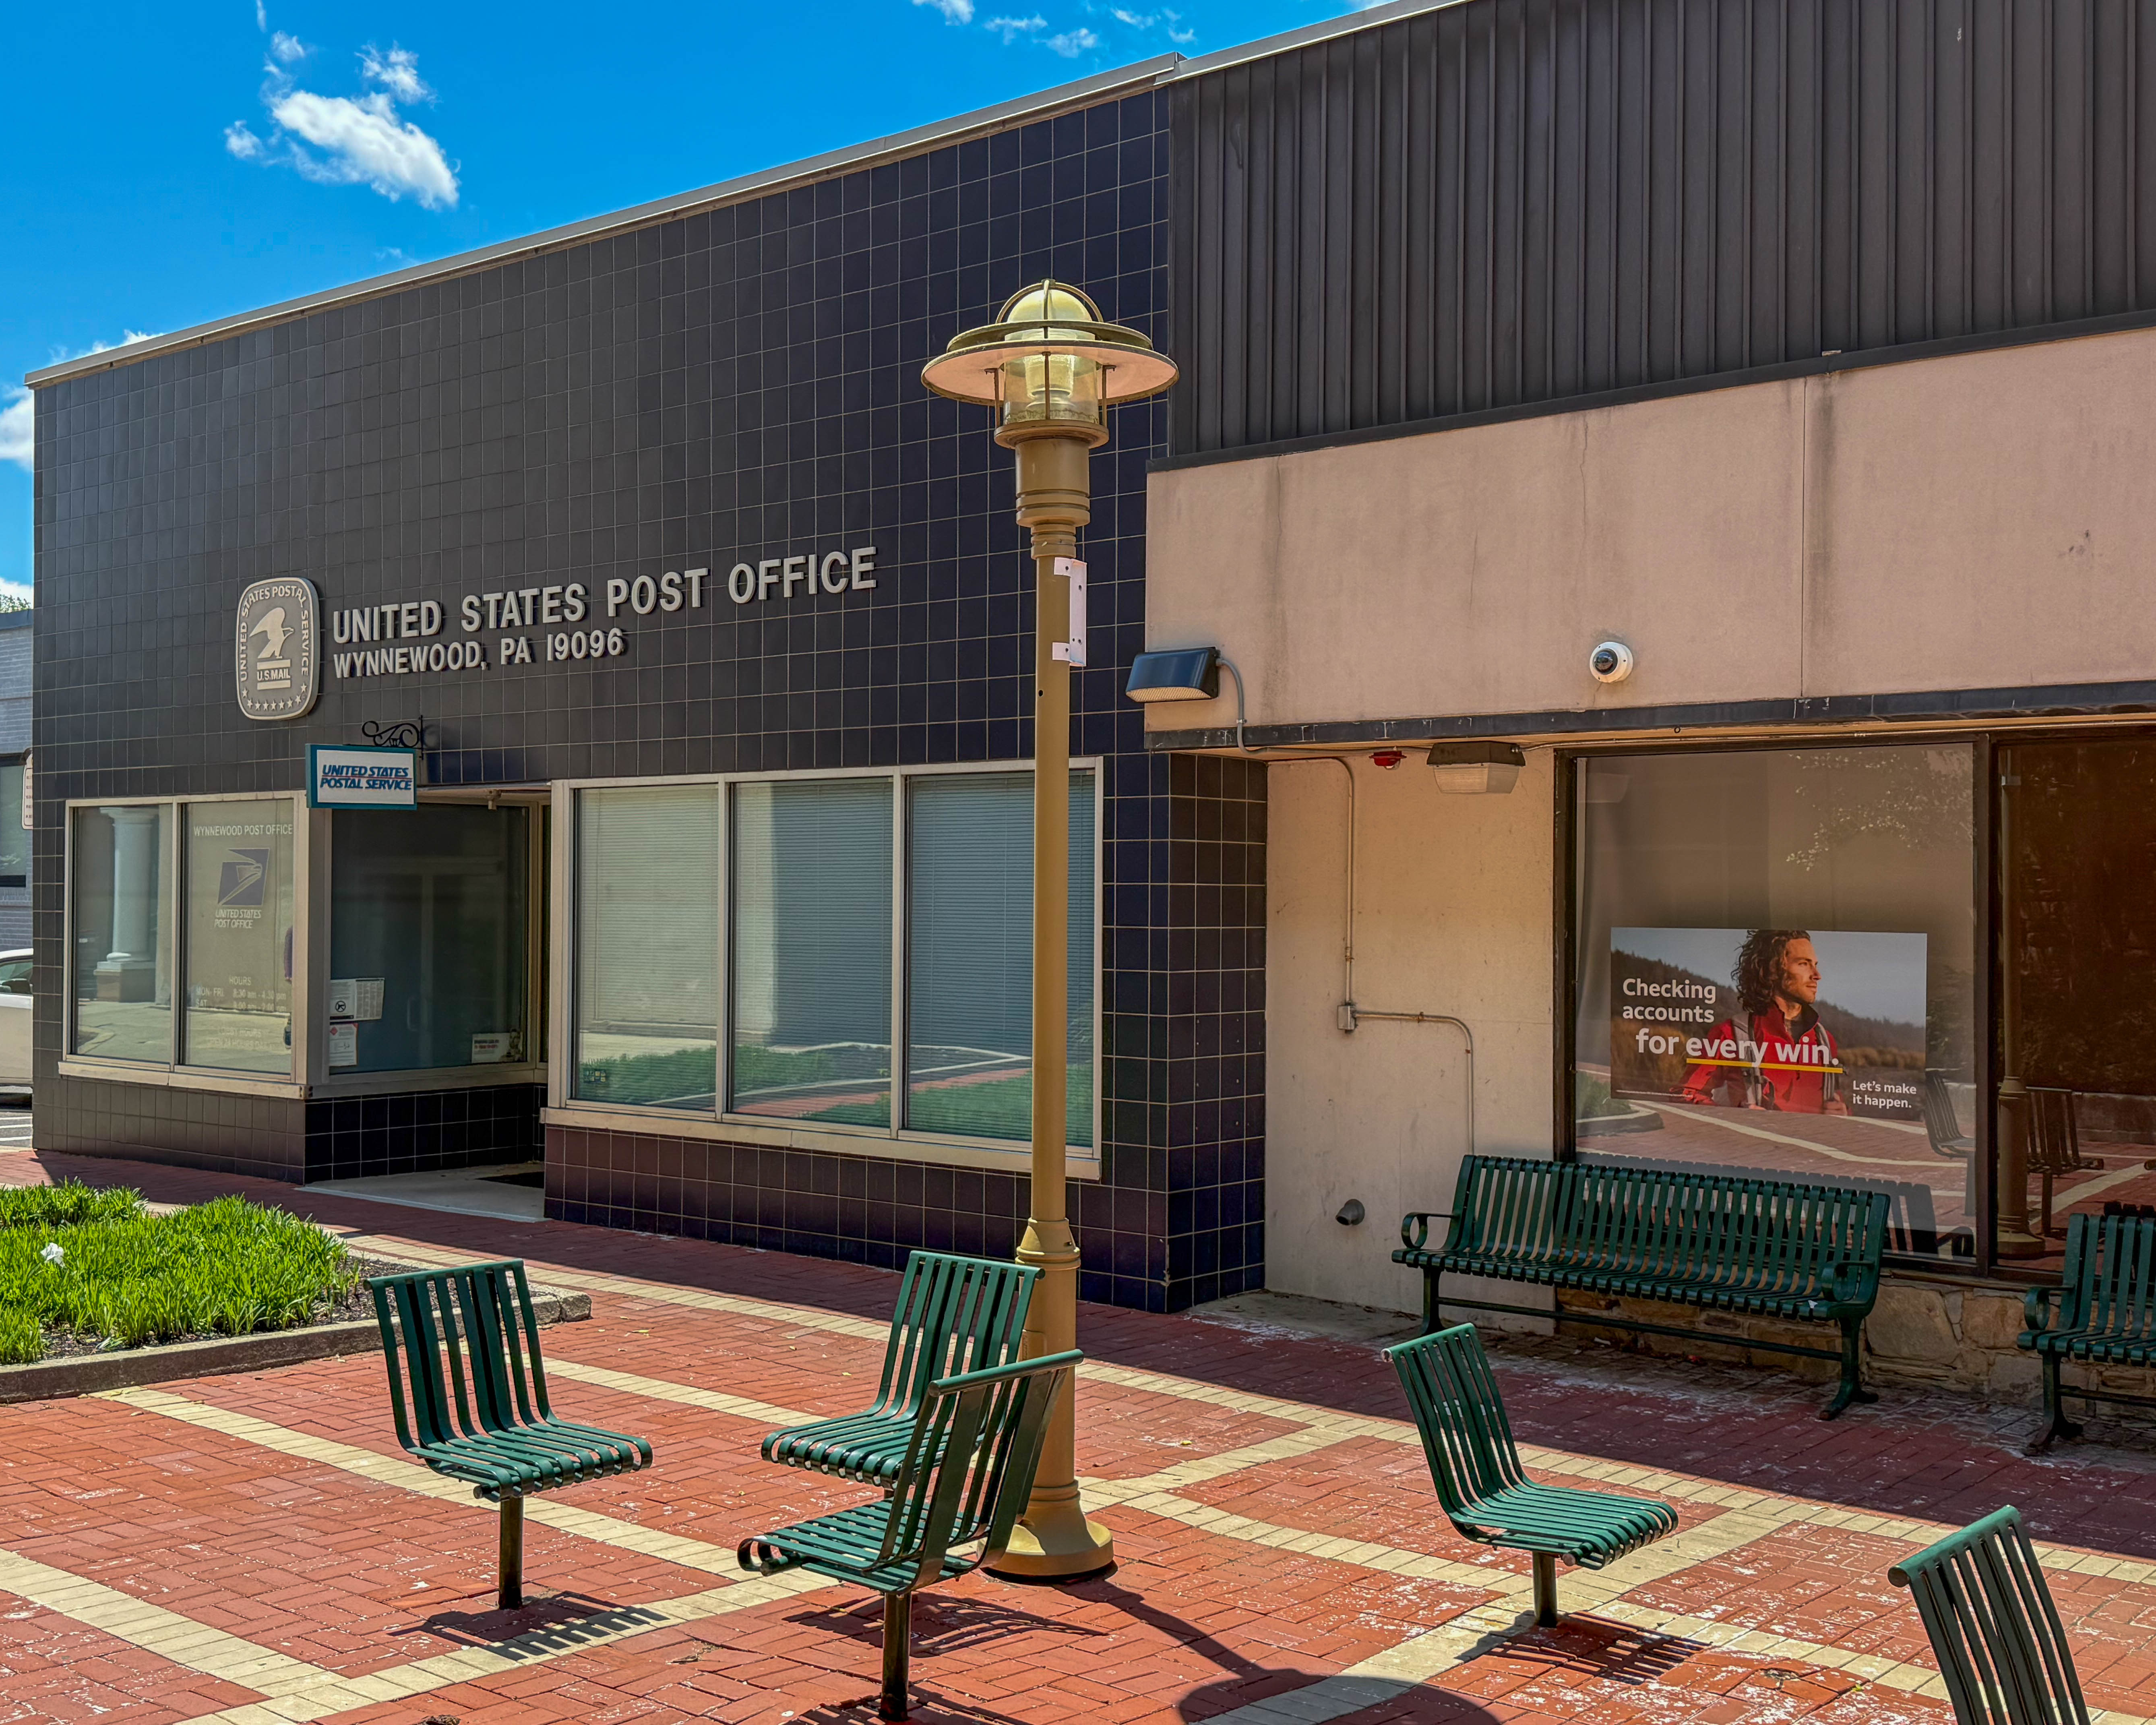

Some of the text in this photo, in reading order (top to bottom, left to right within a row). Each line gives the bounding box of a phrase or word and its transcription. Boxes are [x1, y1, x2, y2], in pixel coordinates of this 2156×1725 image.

[333, 546, 876, 643] UNITED STATES POST OFFICE
[242, 587, 270, 618] STATES
[272, 585, 306, 608] POSTAL
[301, 610, 309, 676] SERVICE
[333, 628, 624, 678] WYNNEWOOD, PA 19096
[322, 765, 409, 777] UNITED STATES
[320, 778, 412, 790] POSTAL SERVICE
[194, 824, 293, 836] WYNNEWOOD POST OFFICE
[215, 908, 262, 918] UNITED STATES
[214, 919, 254, 929] POST OFFICE
[229, 975, 252, 986] HOURS
[1623, 978, 1716, 1004] Checking
[1623, 1005, 1715, 1023] accounts
[1635, 1028, 1839, 1067] for every win.
[1883, 1082, 1917, 1094] make
[1852, 1093, 1912, 1110] it happen.
